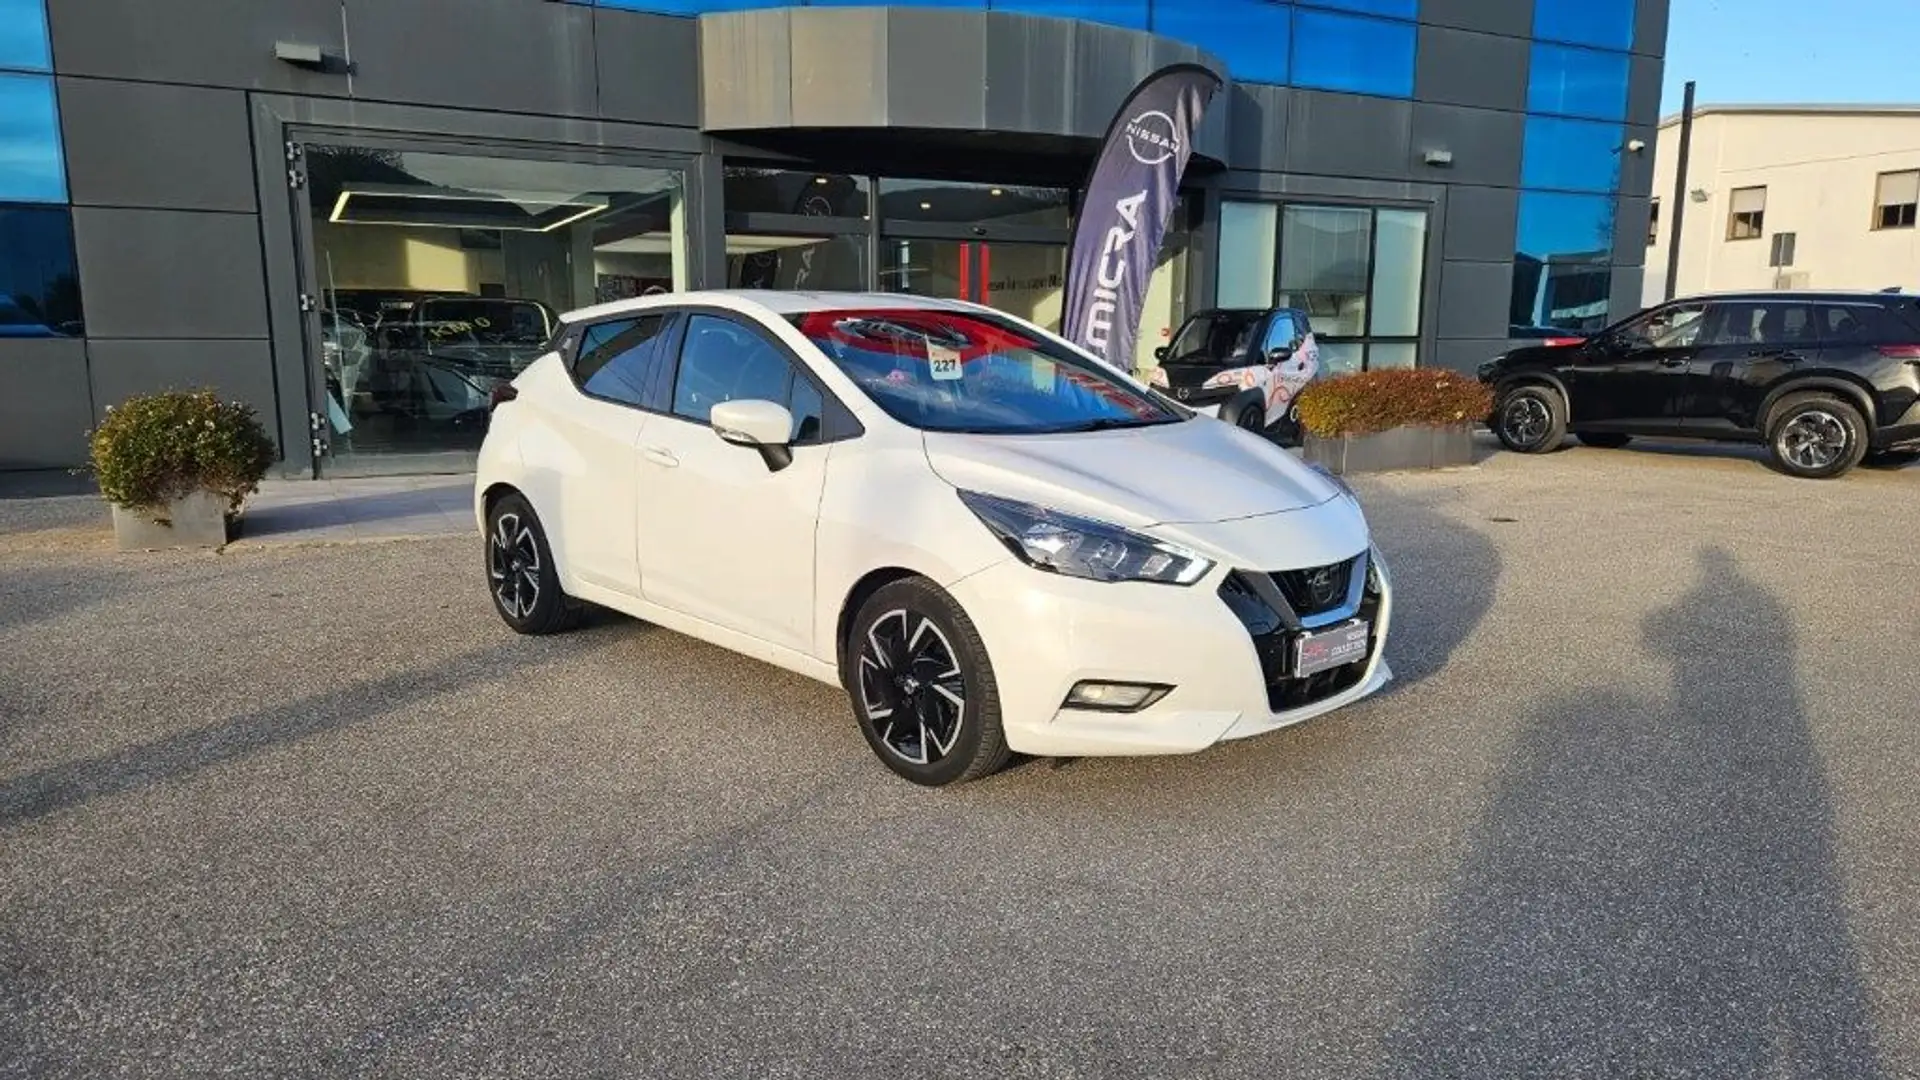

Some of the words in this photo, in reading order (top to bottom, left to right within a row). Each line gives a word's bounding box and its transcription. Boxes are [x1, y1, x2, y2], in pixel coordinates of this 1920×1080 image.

[1126, 122, 1179, 153] NISSAN
[1086, 189, 1148, 354] MICRA
[933, 358, 957, 373] 227
